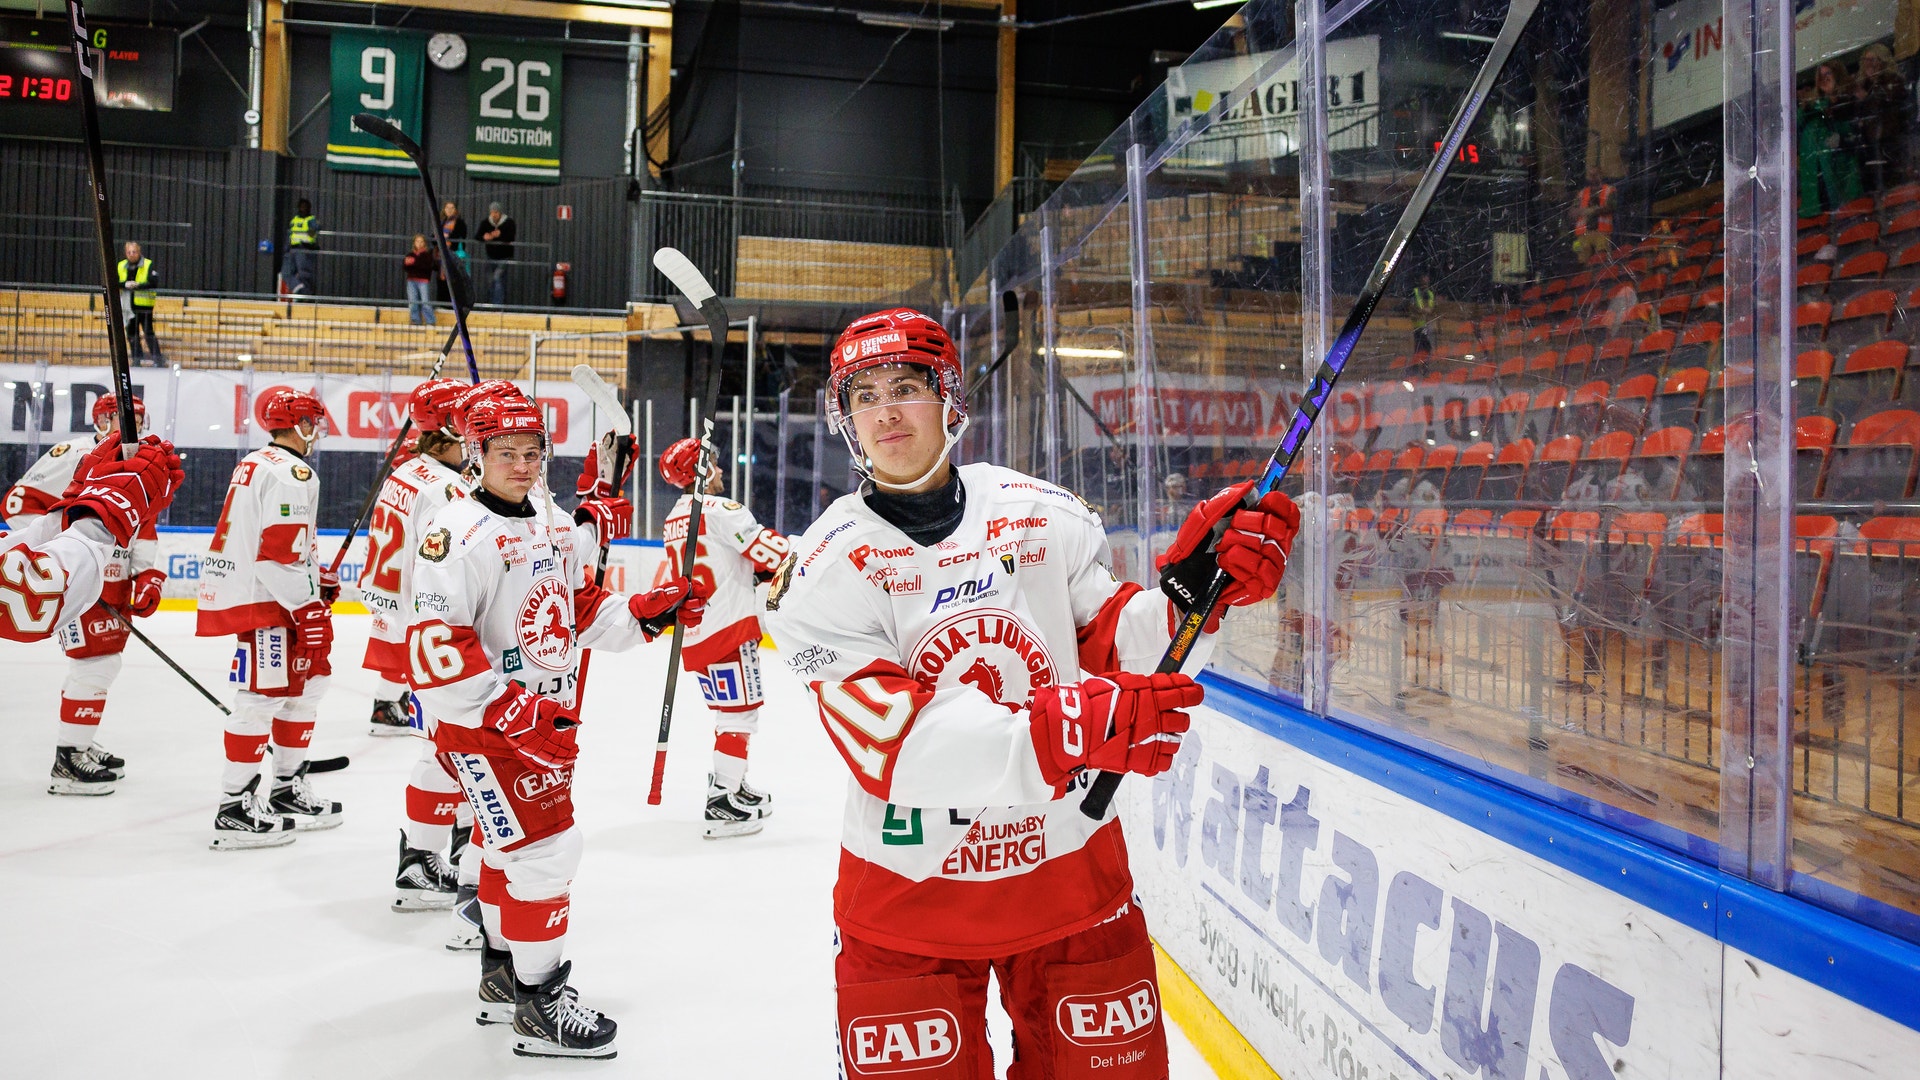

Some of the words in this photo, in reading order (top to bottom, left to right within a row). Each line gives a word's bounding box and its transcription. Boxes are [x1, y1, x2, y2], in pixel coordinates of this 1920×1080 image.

[109, 50, 140, 61] PLAYER
[360, 46, 396, 110] 9
[480, 57, 551, 121] 26
[475, 125, 552, 147] NORDSTRÖM
[1435, 131, 1461, 174] ULTRALOW
[1456, 92, 1481, 135] KICKPOINT
[861, 333, 901, 349] SVENSKA
[862, 345, 882, 357] SPEL
[693, 418, 715, 503] CCM
[1010, 482, 1075, 502] INTERSPORT
[463, 513, 491, 541] INTERSPORT
[663, 518, 691, 541] SKAGE
[803, 519, 857, 567] INTERSPORT
[749, 529, 791, 570] 96
[938, 551, 980, 568] CCM
[1019, 547, 1047, 563] etall
[270, 634, 282, 668] BUSS
[408, 623, 465, 686] 16
[523, 630, 540, 647] IF
[537, 645, 557, 661] 1948
[495, 687, 535, 732] CCM
[819, 676, 914, 782] 10
[480, 788, 515, 838] BUSS
[981, 813, 1047, 841] LJUNGBY
[941, 832, 1047, 875] ENERGI
[1199, 903, 1239, 989] Bygg
[1251, 947, 1308, 1045] Mark
[1066, 987, 1156, 1039] EAB
[853, 1017, 953, 1065] EAB
[1090, 1054, 1113, 1070] Det
